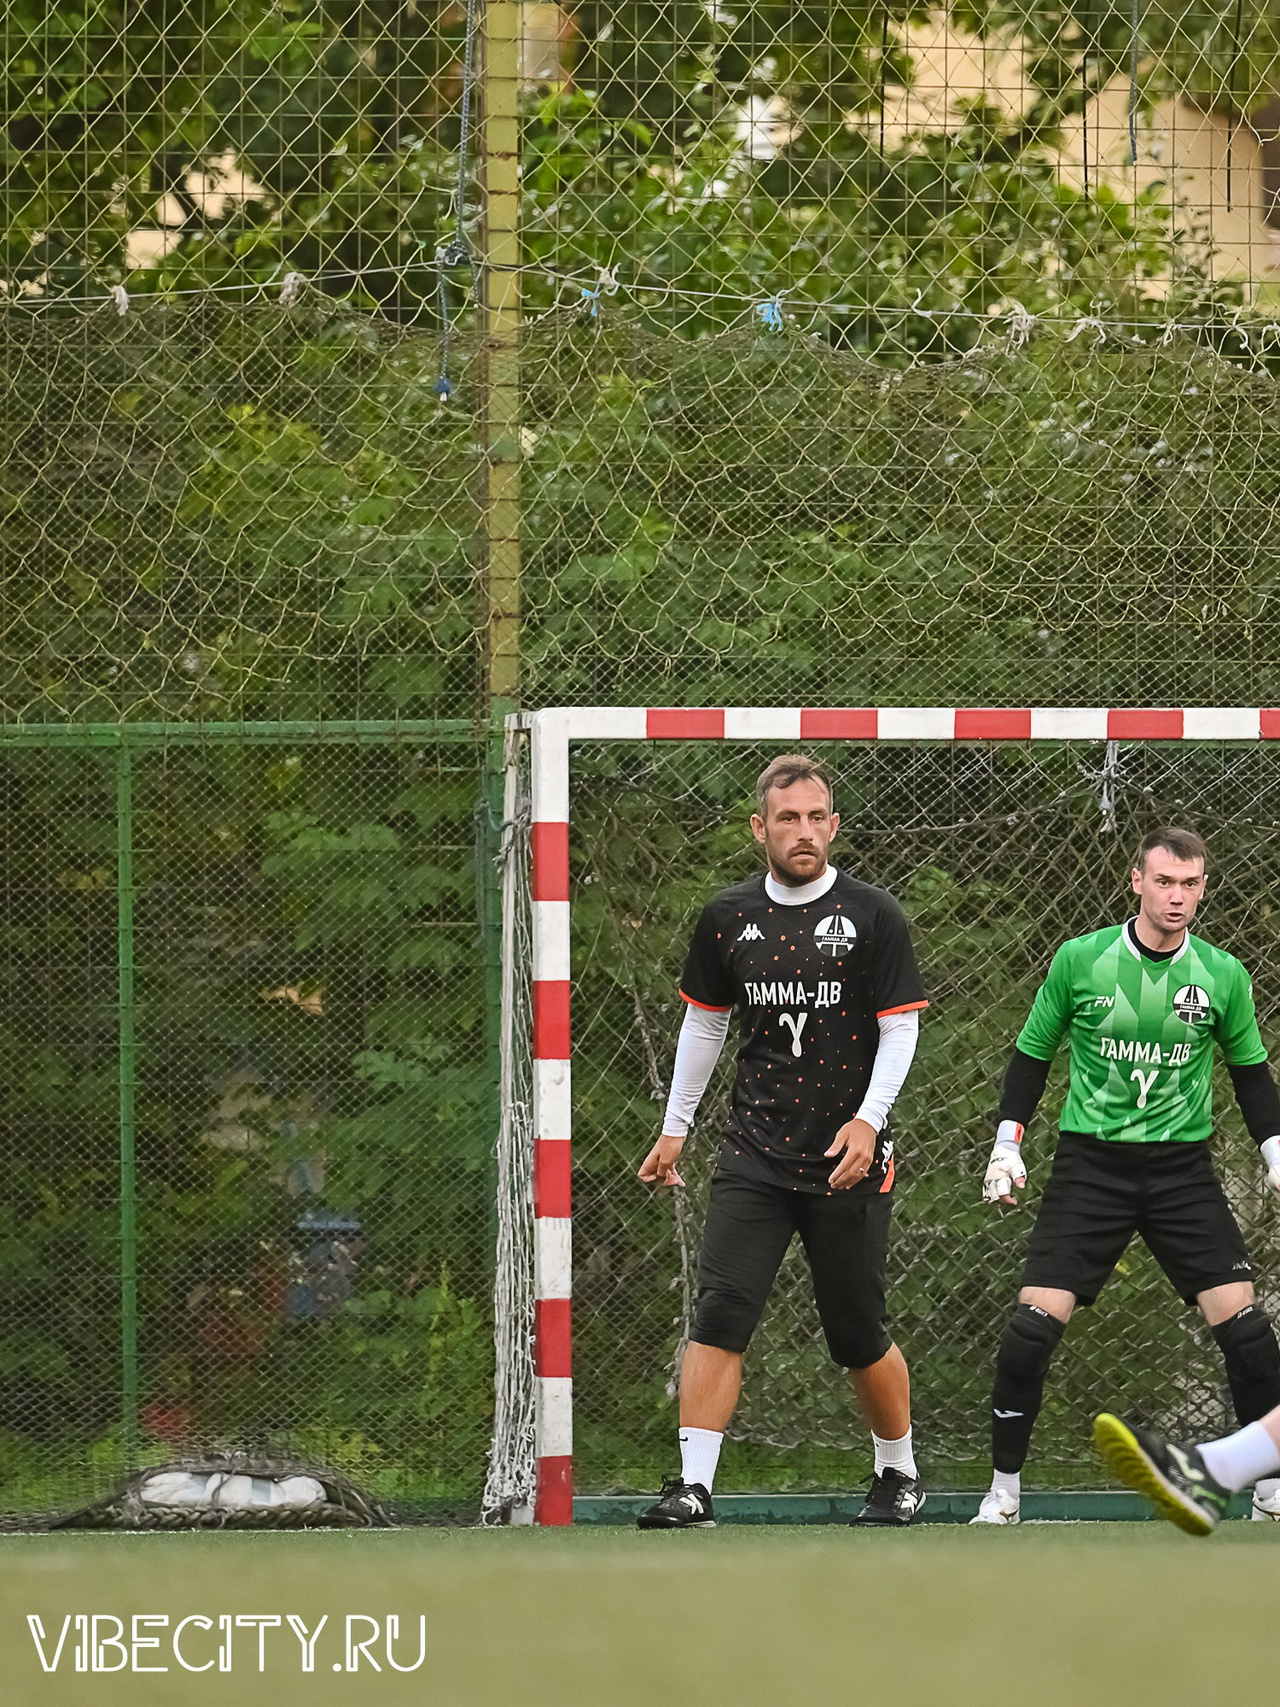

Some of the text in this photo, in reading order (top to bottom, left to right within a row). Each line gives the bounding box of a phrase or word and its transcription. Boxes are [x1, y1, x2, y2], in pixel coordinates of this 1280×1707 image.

[744, 981, 842, 1008] ГАММА-ДВ
[1094, 996, 1115, 1008] FN
[1100, 1037, 1191, 1066] ГАММА-ДВ
